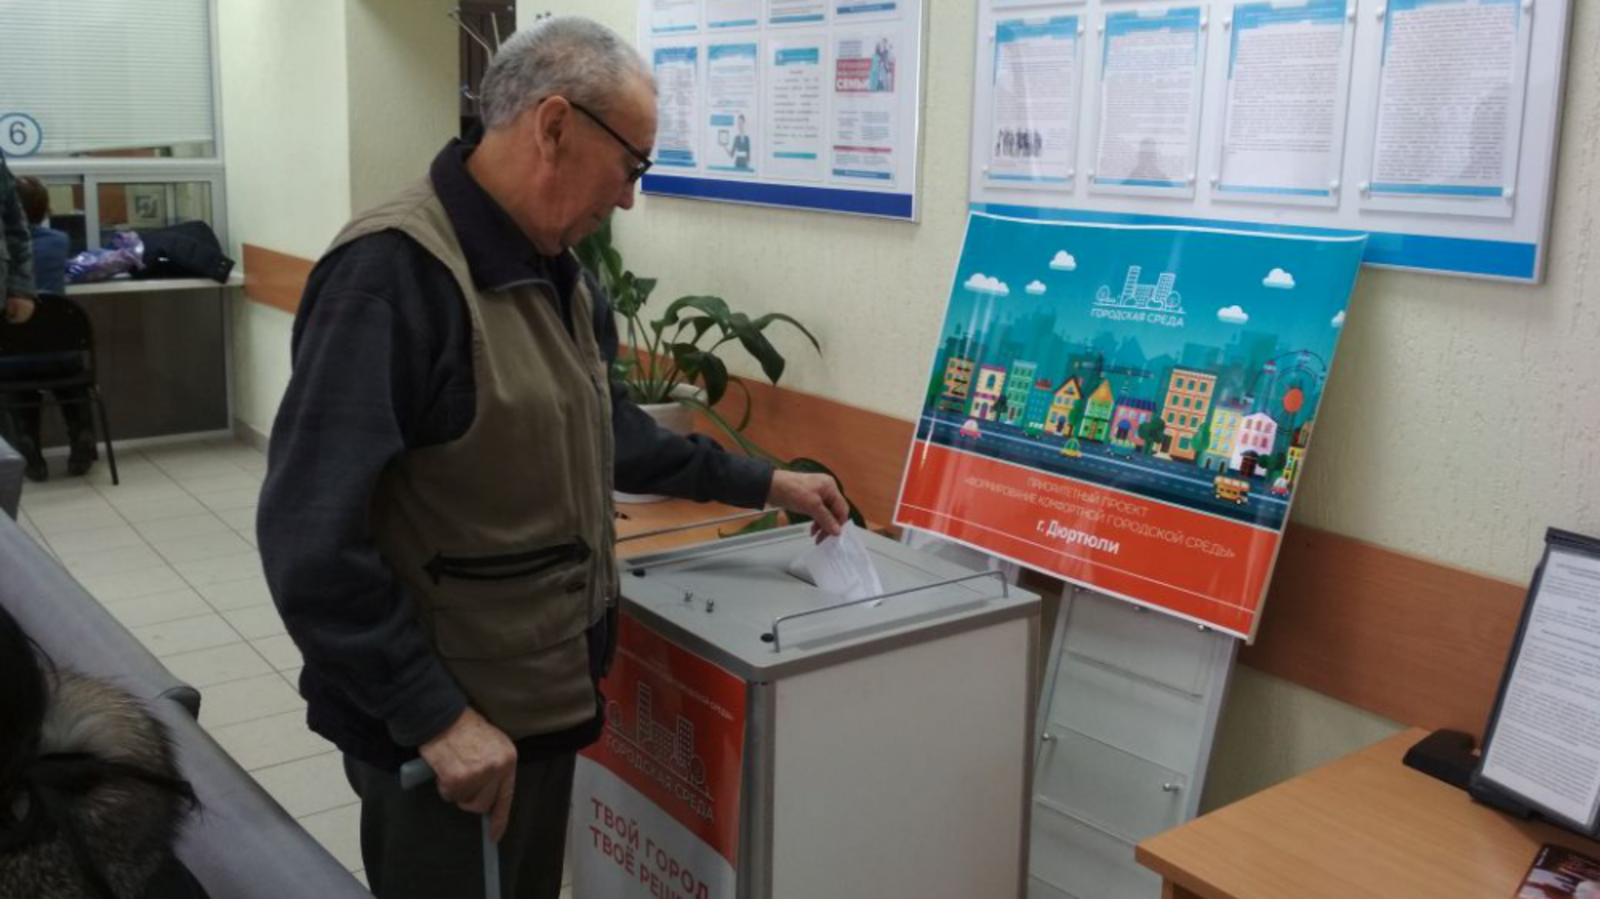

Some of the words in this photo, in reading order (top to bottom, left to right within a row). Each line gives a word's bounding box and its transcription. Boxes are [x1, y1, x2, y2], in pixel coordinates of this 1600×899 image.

[9, 121, 27, 146] 6
[1091, 308, 1146, 321] ГОРОДСКАЯ
[1147, 312, 1184, 327] СРЕДА
[1028, 477, 1100, 504] ПРИОРИТЕТНЫЙ
[1101, 494, 1149, 517] ПРОЕКТ
[1036, 519, 1045, 533] г.
[1046, 520, 1120, 555] Дюртюли
[1037, 497, 1105, 523] КОМФОРТНОЙ
[1107, 515, 1183, 544] ГОРОДСКОЙ
[1185, 537, 1235, 558] СРЕДЫ»
[605, 734, 672, 793] ГОРОДСКАЯ
[674, 783, 715, 824] СРЕДА
[590, 825, 635, 876] ТВОЁ
[640, 862, 685, 899] РЕШ
[591, 796, 639, 850] ТВОЙ
[645, 837, 709, 899] ГОРОД
